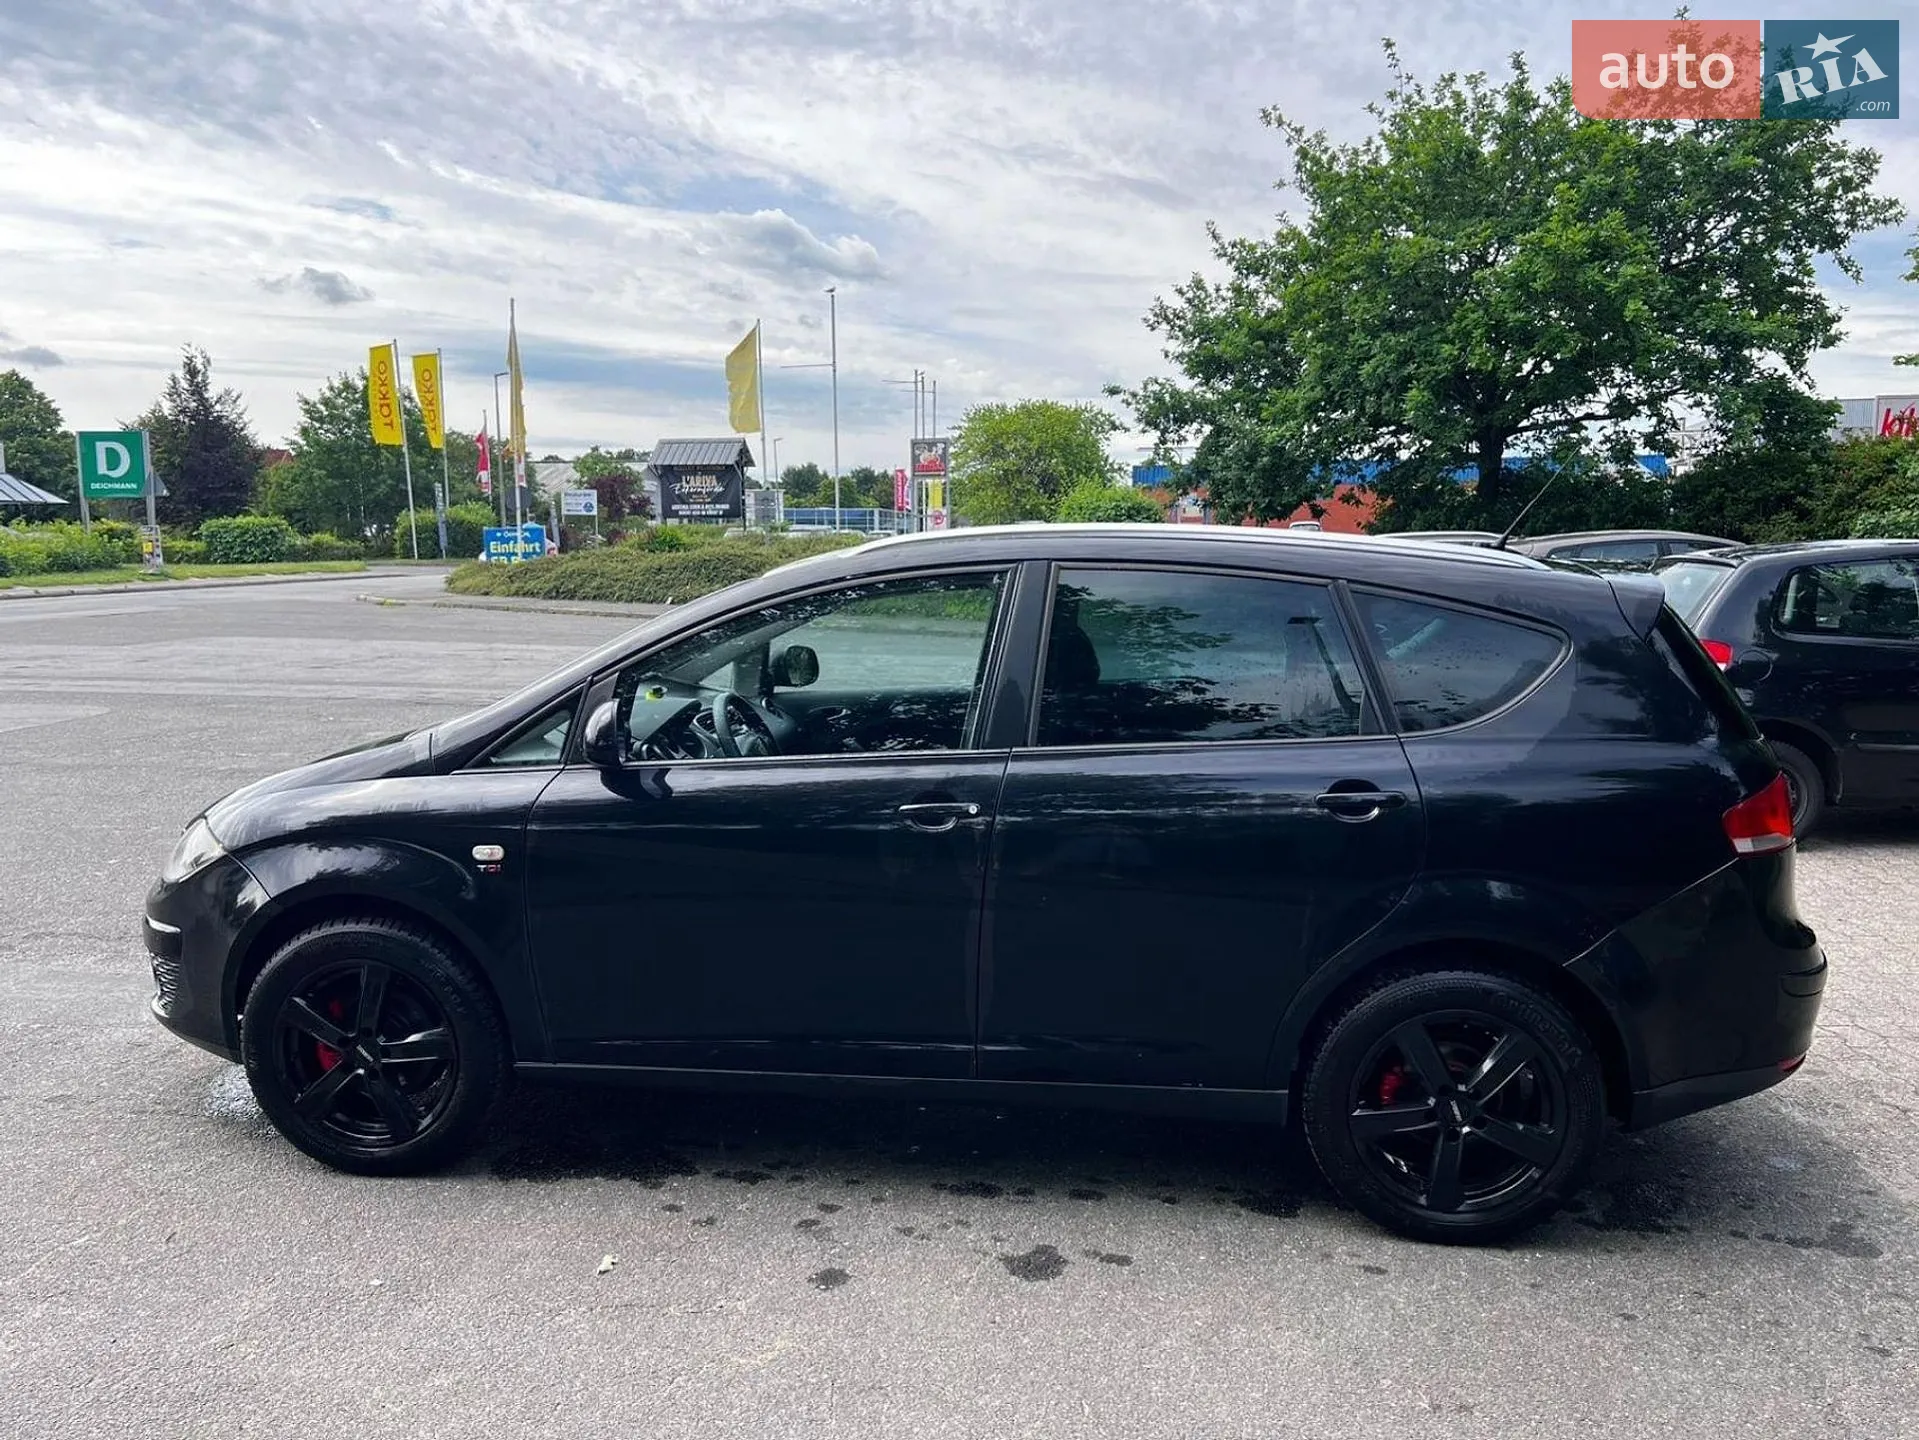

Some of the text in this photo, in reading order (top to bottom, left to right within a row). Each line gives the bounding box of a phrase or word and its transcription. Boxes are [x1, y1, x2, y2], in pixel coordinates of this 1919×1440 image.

[95, 441, 131, 478] D
[91, 482, 138, 490] DEICHMANN
[489, 540, 541, 554] Einfahrt
